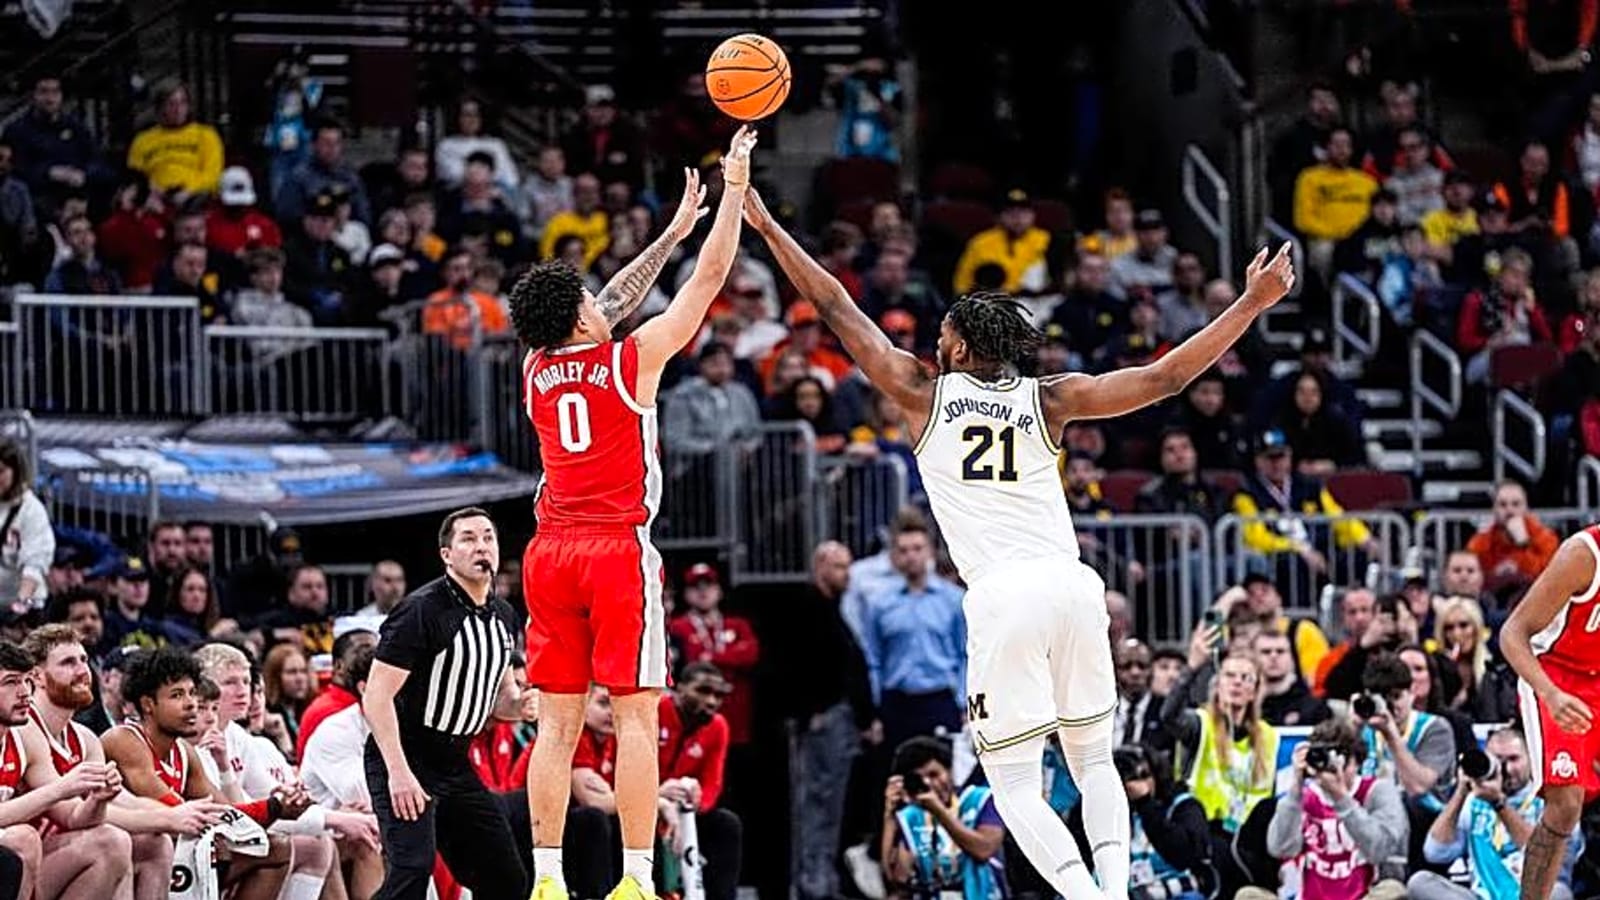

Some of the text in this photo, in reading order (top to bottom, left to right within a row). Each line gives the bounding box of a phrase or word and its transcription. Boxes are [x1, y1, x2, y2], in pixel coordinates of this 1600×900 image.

[534, 361, 609, 394] MOBLEY JR.
[557, 392, 592, 453] 0
[944, 397, 1013, 424] JOHNSON
[962, 425, 1019, 482] 21
[967, 692, 989, 721] M
